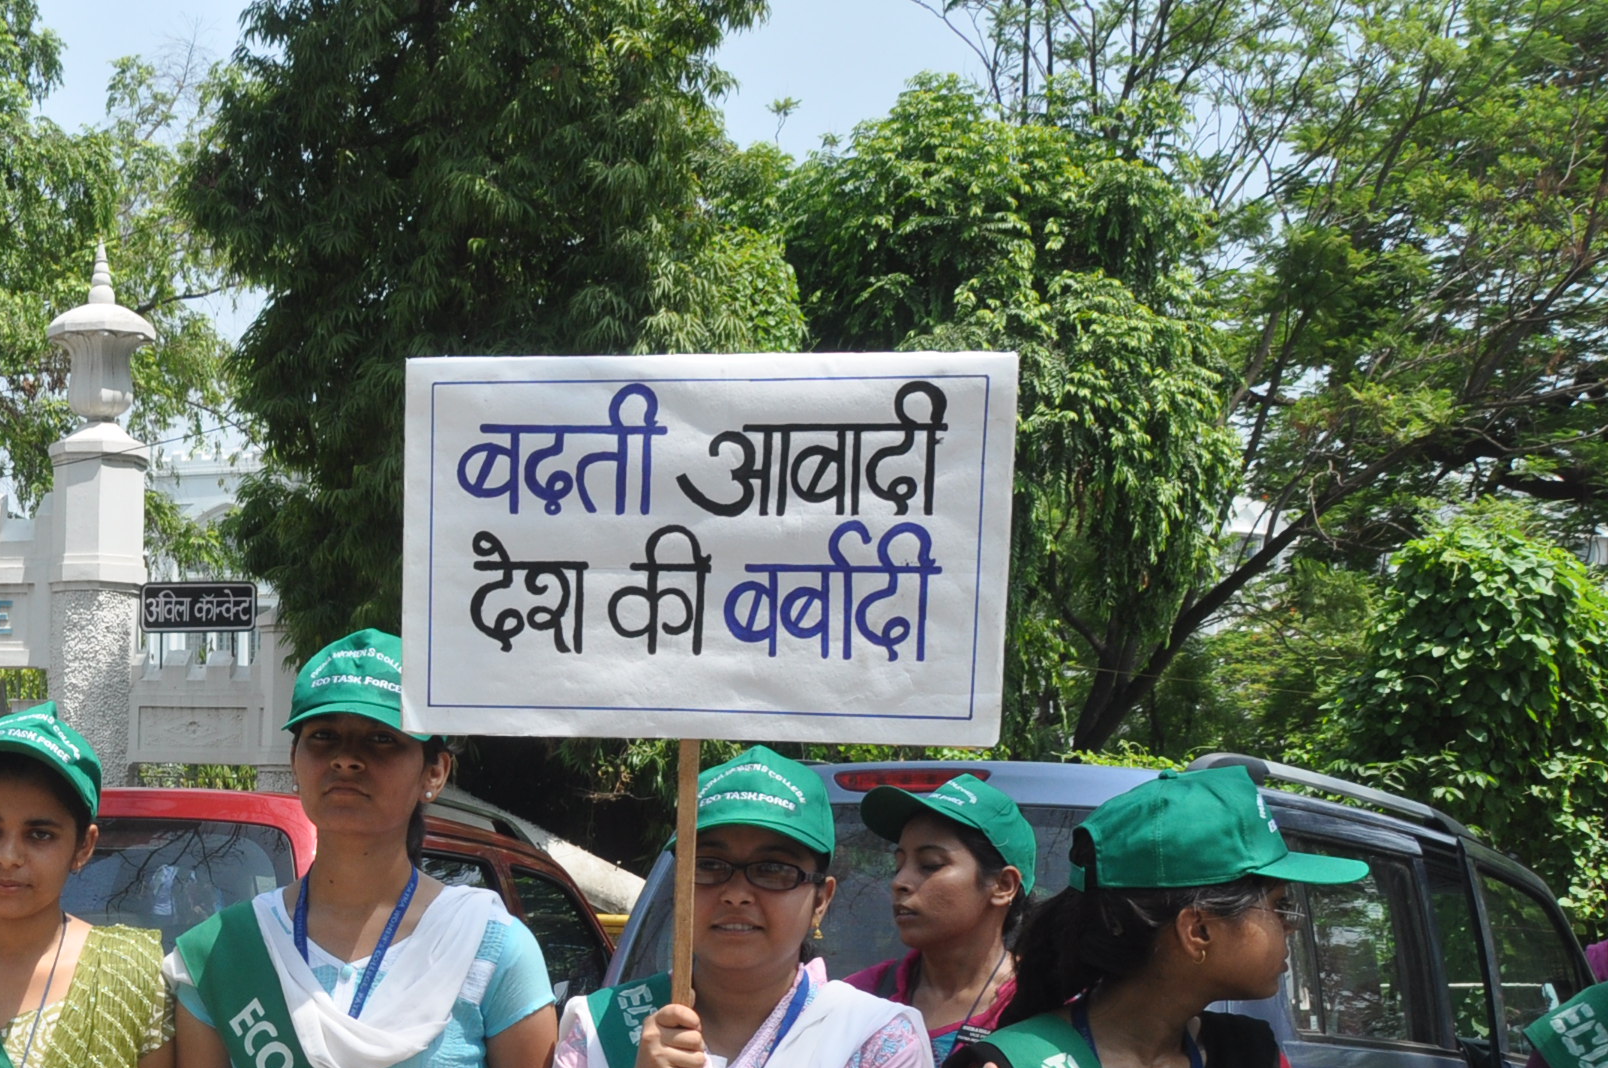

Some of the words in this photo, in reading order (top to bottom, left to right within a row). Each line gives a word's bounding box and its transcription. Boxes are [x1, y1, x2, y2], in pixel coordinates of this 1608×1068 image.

[457, 384, 667, 516] बढ़ती
[676, 380, 948, 516] आबादी
[145, 590, 192, 622] अविला
[470, 531, 589, 653] देश
[608, 525, 711, 655] की
[723, 520, 942, 661] बर्बादी
[332, 675, 362, 684] TASK
[364, 676, 402, 694] FORCE
[8, 729, 37, 741] TASK
[36, 736, 72, 763] FORCE
[725, 791, 757, 801] TASK
[756, 792, 797, 811] FORCE
[617, 984, 658, 1046] EC
